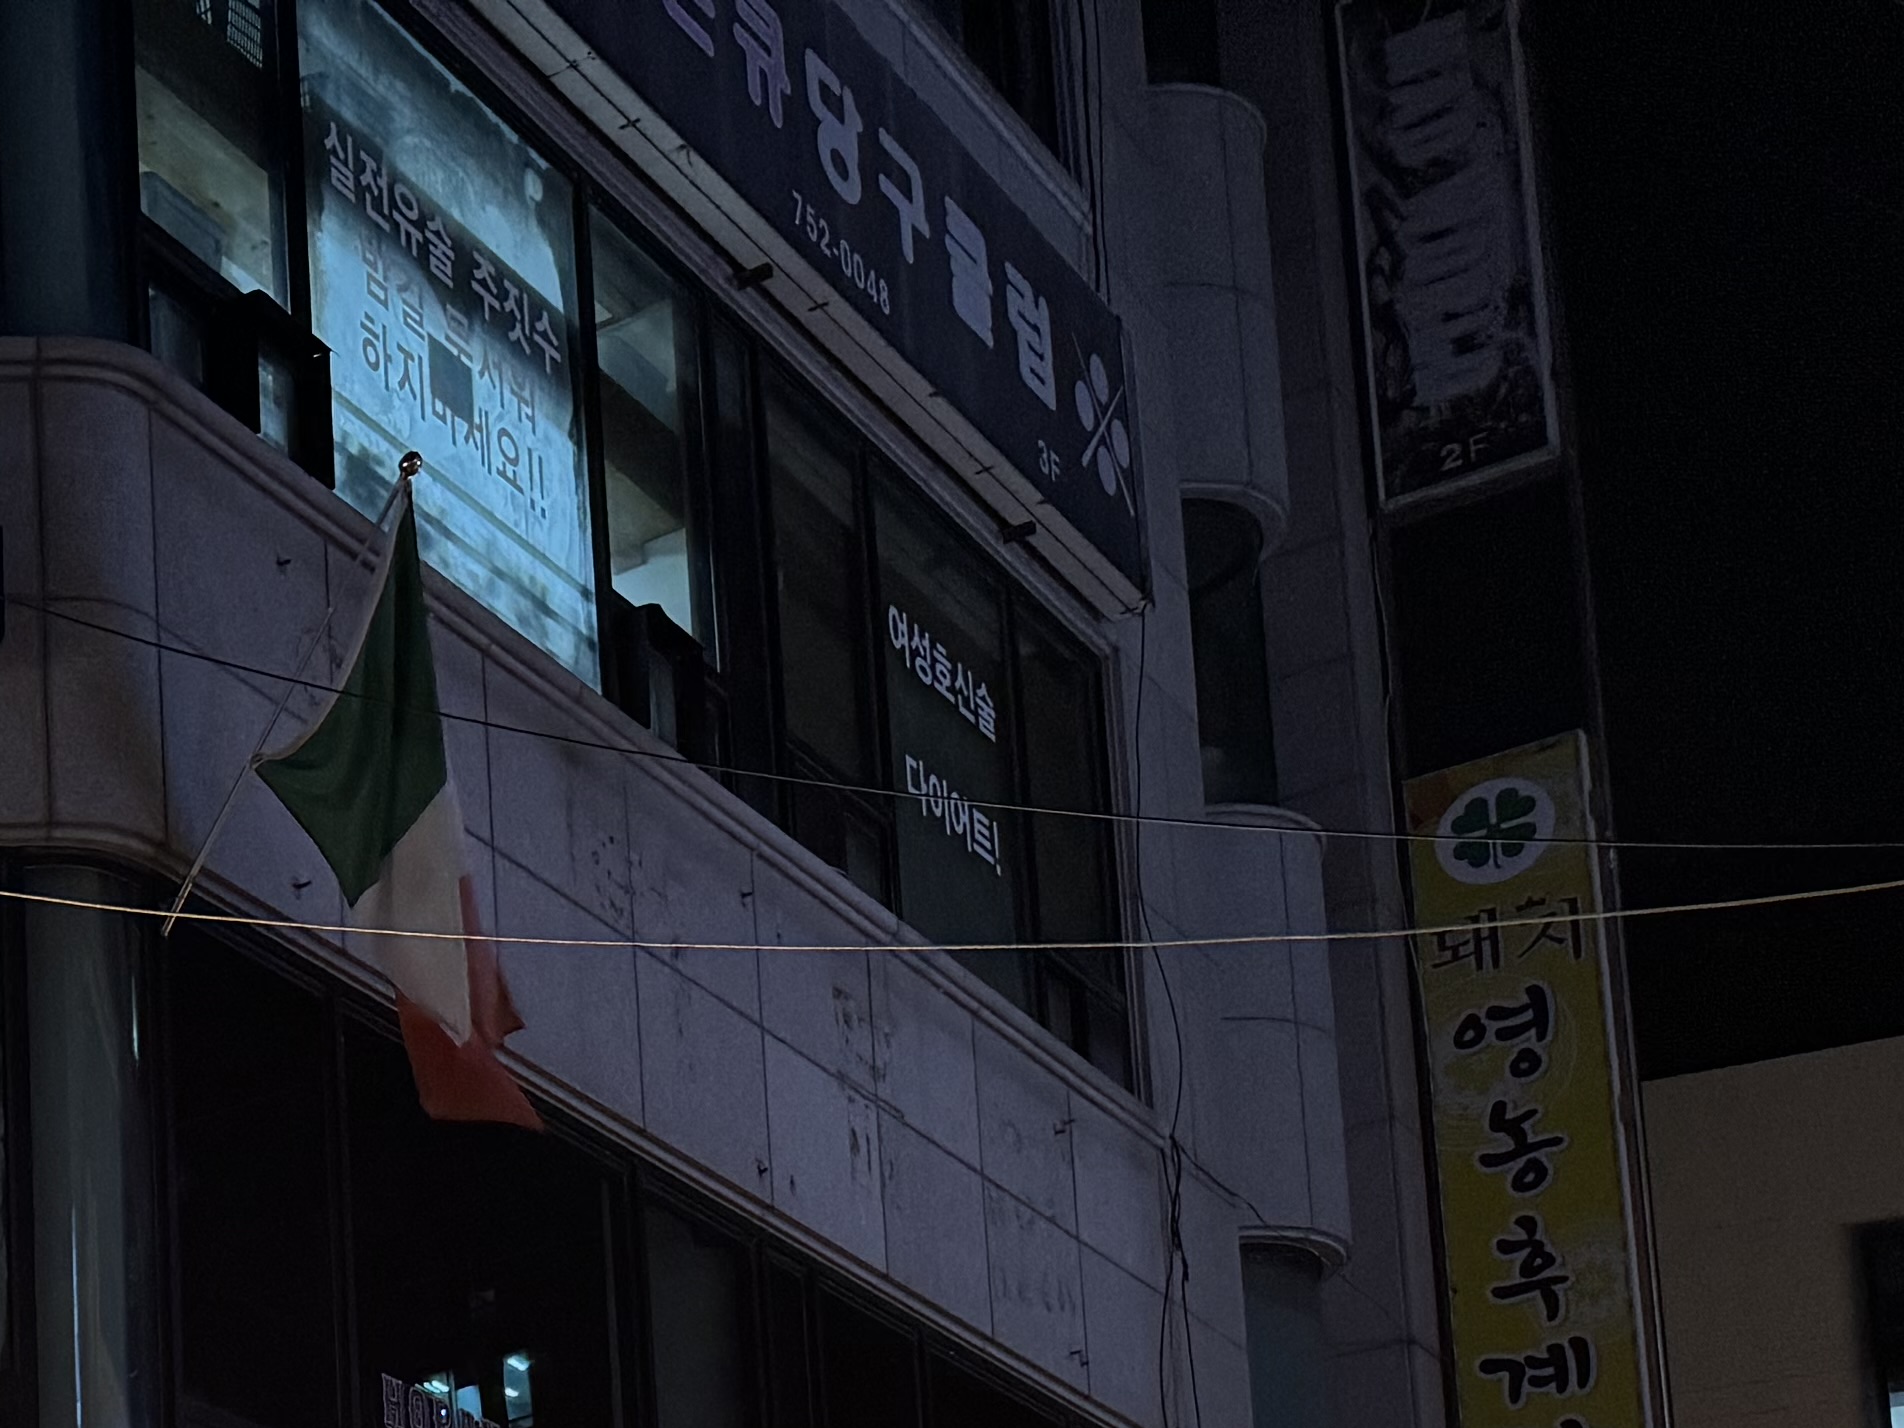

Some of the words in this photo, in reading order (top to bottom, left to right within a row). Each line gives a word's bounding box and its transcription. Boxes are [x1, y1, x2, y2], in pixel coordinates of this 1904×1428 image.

[323, 121, 457, 290] 실전유술
[470, 249, 563, 375] 주짓수
[792, 188, 891, 316] 752-0048
[1439, 432, 1491, 472] 2F
[888, 604, 996, 743] 여성호신술
